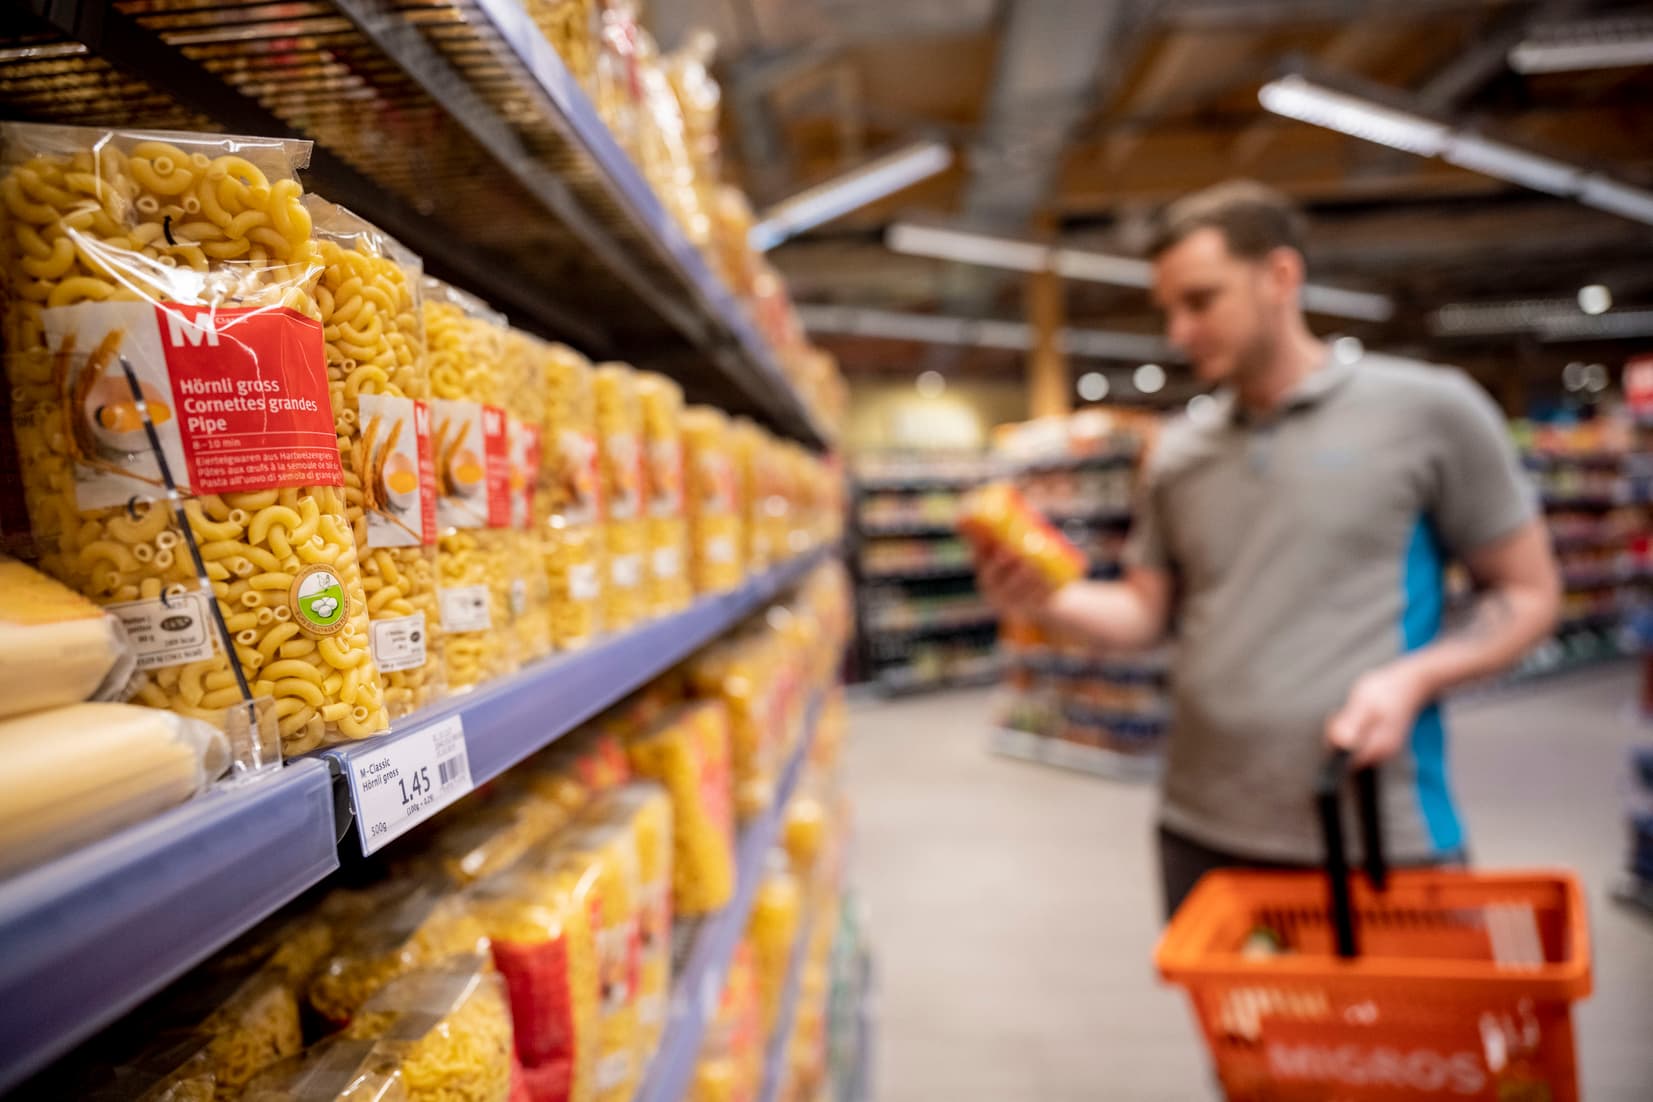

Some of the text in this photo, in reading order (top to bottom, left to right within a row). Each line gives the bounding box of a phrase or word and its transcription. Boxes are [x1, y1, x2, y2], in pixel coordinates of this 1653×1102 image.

[166, 309, 220, 348] M
[179, 377, 280, 396] Hörnli gross
[184, 396, 318, 414] Cornettes grandes
[187, 415, 228, 436] Pipe
[222, 438, 241, 448] min
[262, 453, 279, 462] aus
[198, 467, 225, 477] Pâtes
[227, 466, 244, 475] aux
[200, 479, 228, 488] Pasta
[360, 757, 391, 778] M-Classic
[382, 768, 400, 785] gross
[398, 766, 431, 805] 1.45
[371, 822, 388, 837] 500g
